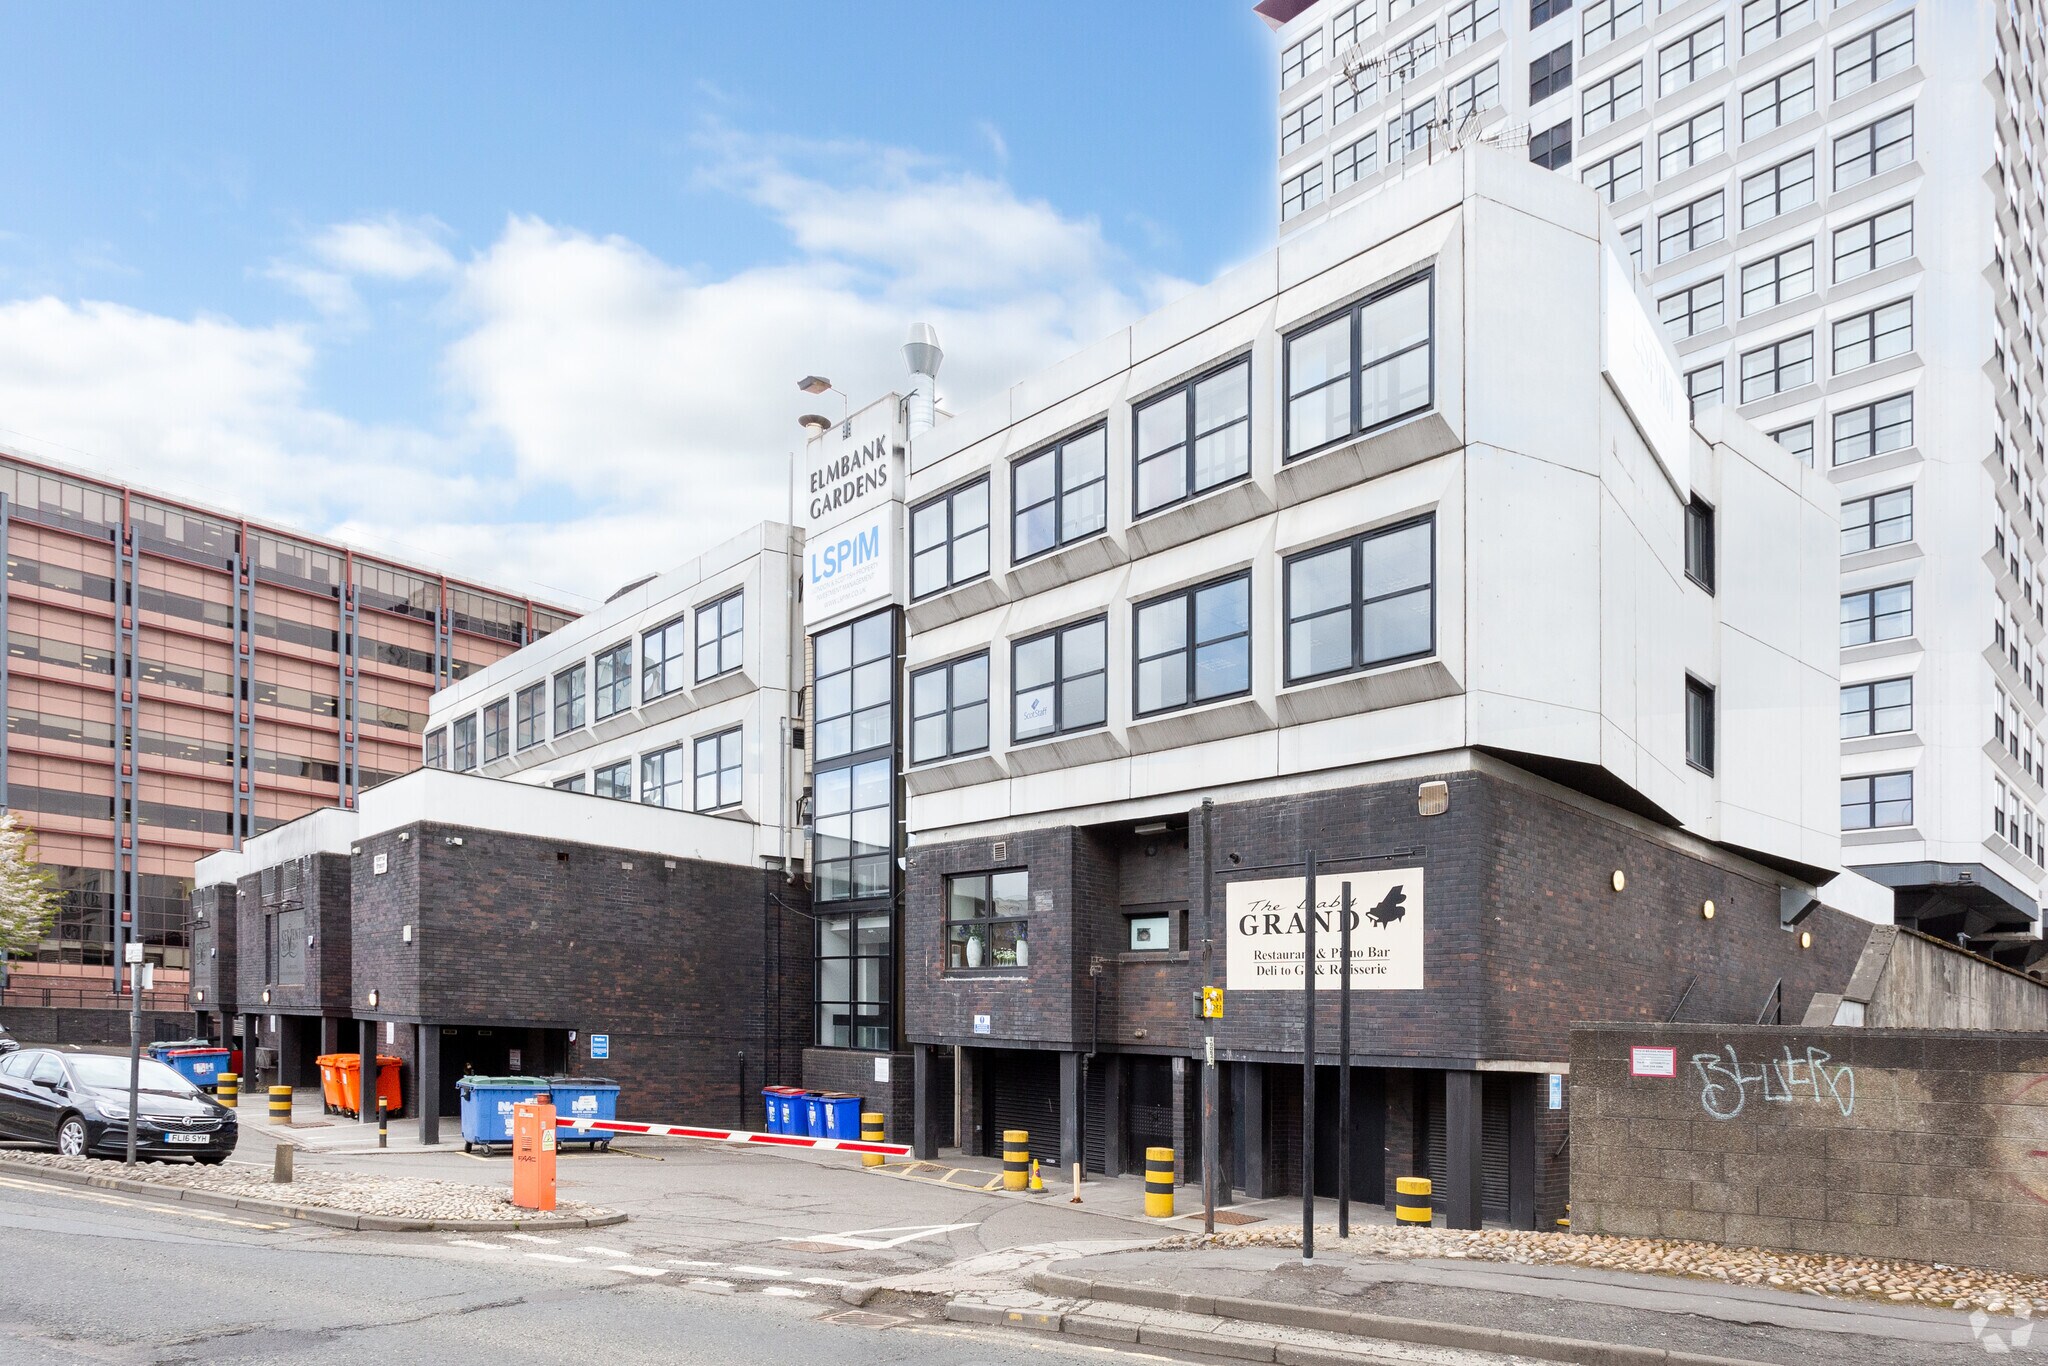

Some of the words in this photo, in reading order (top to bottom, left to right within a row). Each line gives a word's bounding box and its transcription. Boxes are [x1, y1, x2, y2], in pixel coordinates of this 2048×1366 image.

[810, 434, 886, 494] ELMBANK
[810, 463, 887, 520] GARDENS
[812, 524, 879, 584] LSPIM
[1248, 899, 1288, 912] The
[1239, 910, 1360, 937] GRAND
[1316, 947, 1326, 959] &
[1331, 947, 1364, 959] Pino
[1368, 946, 1390, 958] Bar
[1257, 965, 1278, 976] Deli
[1281, 966, 1291, 976] to
[1315, 963, 1325, 975] &
[171, 1134, 189, 1142] FL16
[192, 1134, 207, 1142] SYH
